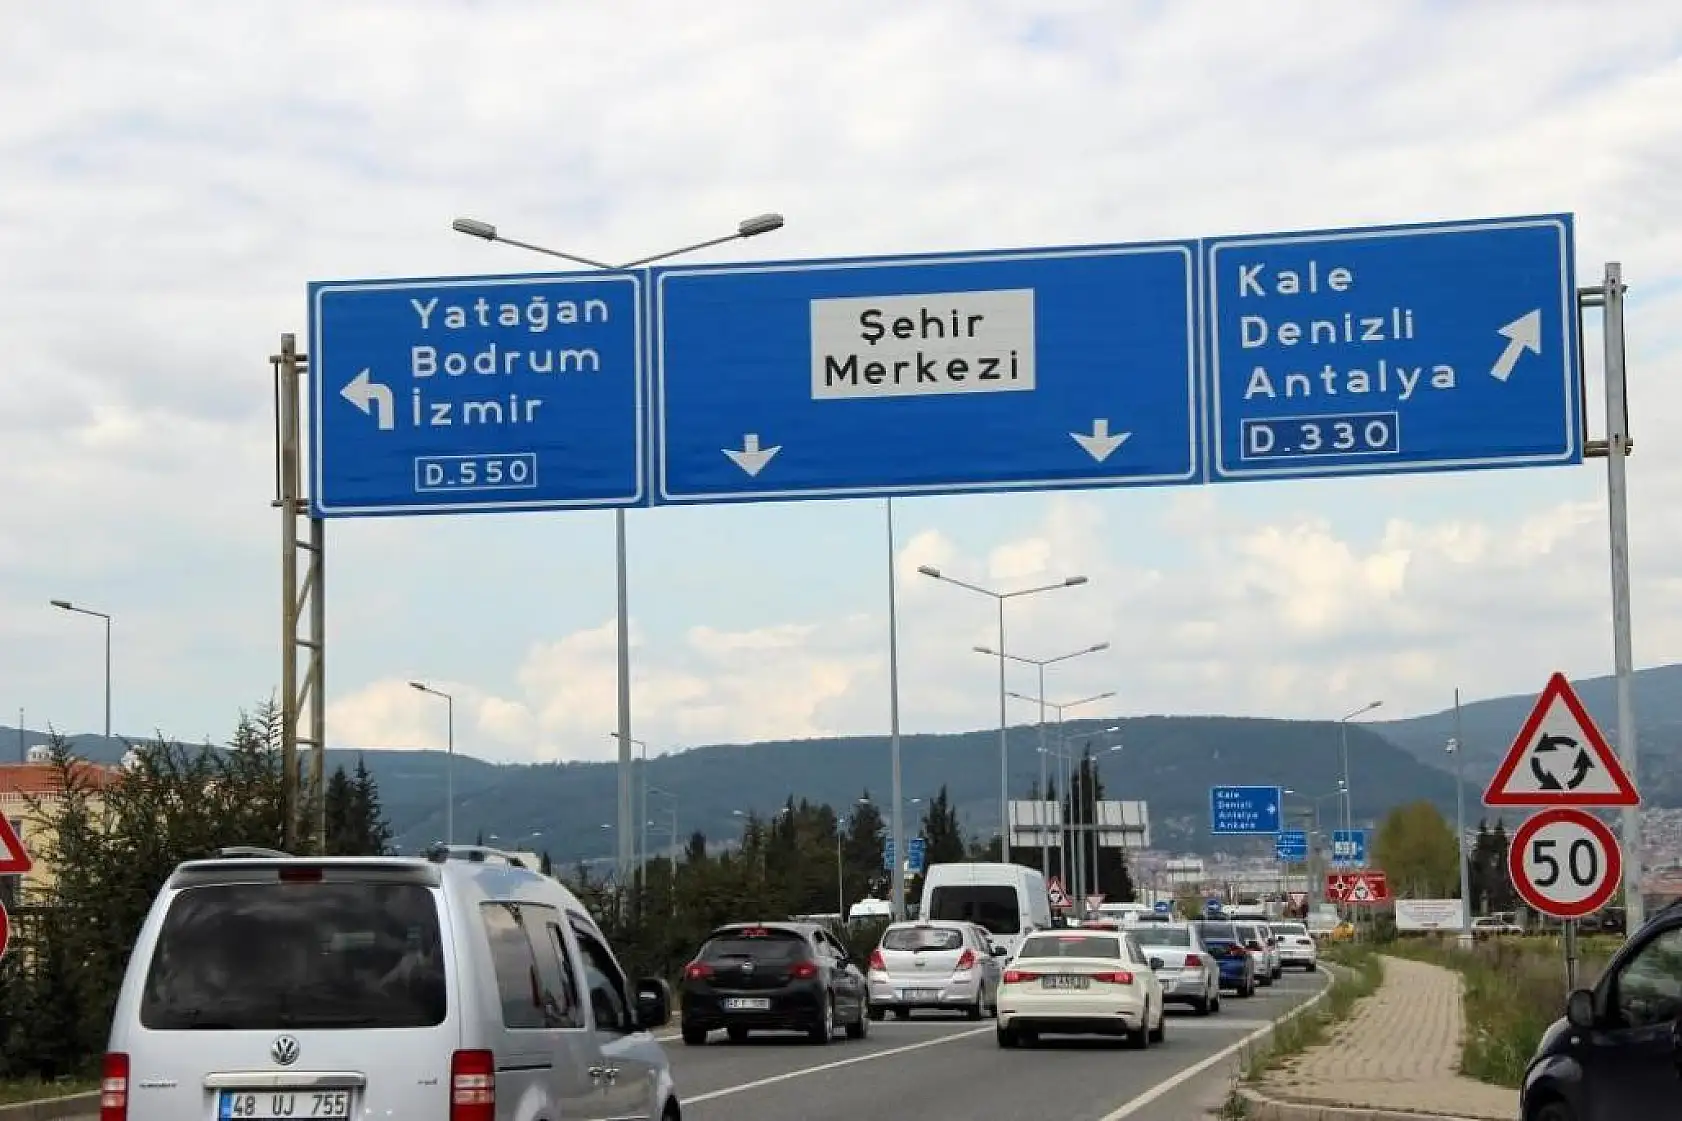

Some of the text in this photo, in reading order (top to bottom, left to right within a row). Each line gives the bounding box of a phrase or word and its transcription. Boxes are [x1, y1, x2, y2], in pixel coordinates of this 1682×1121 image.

[1238, 259, 1353, 297] Kale
[409, 296, 609, 333] Yatağan
[859, 307, 984, 346] Şehir
[1239, 306, 1414, 349] Denizli
[410, 342, 600, 378] Bodrum
[825, 350, 1018, 387] Merkezi
[1243, 359, 1456, 401] Antalya
[411, 387, 543, 427] İzmir
[1250, 420, 1390, 453] D.330
[425, 459, 529, 486] D.550
[1532, 838, 1599, 887] 50
[233, 1094, 346, 1117] 48 UJ 755
